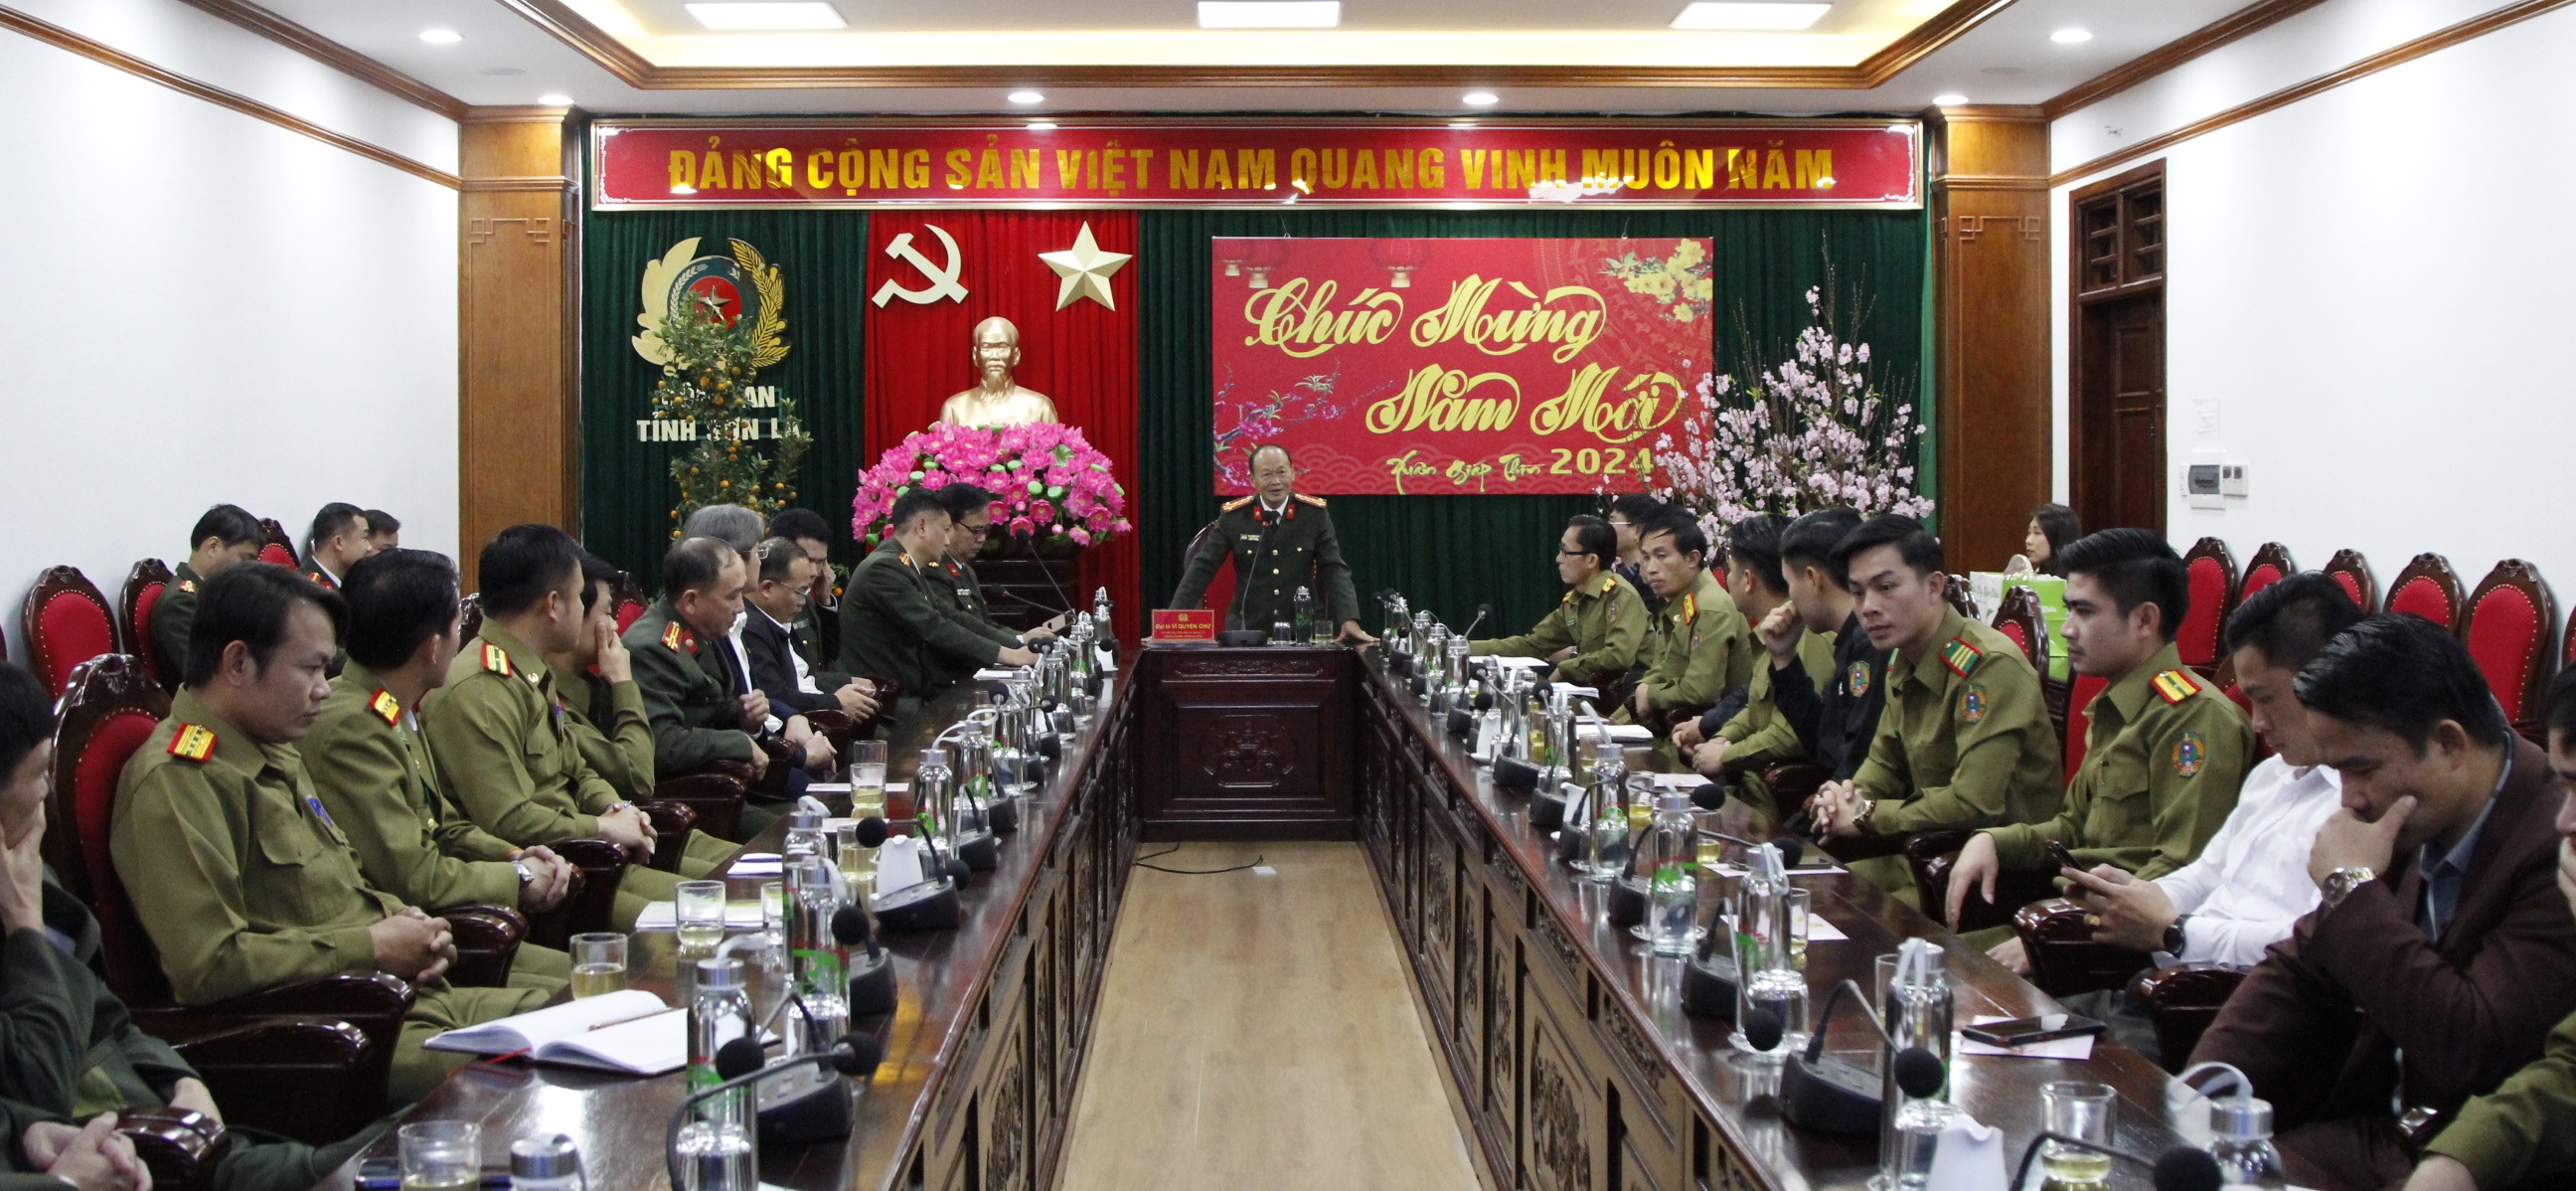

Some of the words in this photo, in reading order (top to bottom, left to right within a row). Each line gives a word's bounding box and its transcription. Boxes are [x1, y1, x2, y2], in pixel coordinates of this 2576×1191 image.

[670, 135, 793, 191] ĐẢNG
[807, 138, 930, 196] CỘNG
[945, 134, 1041, 190] SẢN
[1056, 139, 1154, 196] VIỆT
[1170, 149, 1276, 190] NAM
[1291, 147, 1445, 194] QUANG
[1460, 149, 1567, 189] VINH
[1581, 141, 1713, 191] MUÔN
[1728, 141, 1833, 190] NĂM
[1245, 277, 1403, 358] Chúc
[1410, 273, 1606, 364] Mừng
[1366, 363, 1521, 434] Năm
[1530, 362, 1683, 444] Mới
[1387, 450, 1437, 494] Xuân
[1550, 447, 1655, 474] 2024
